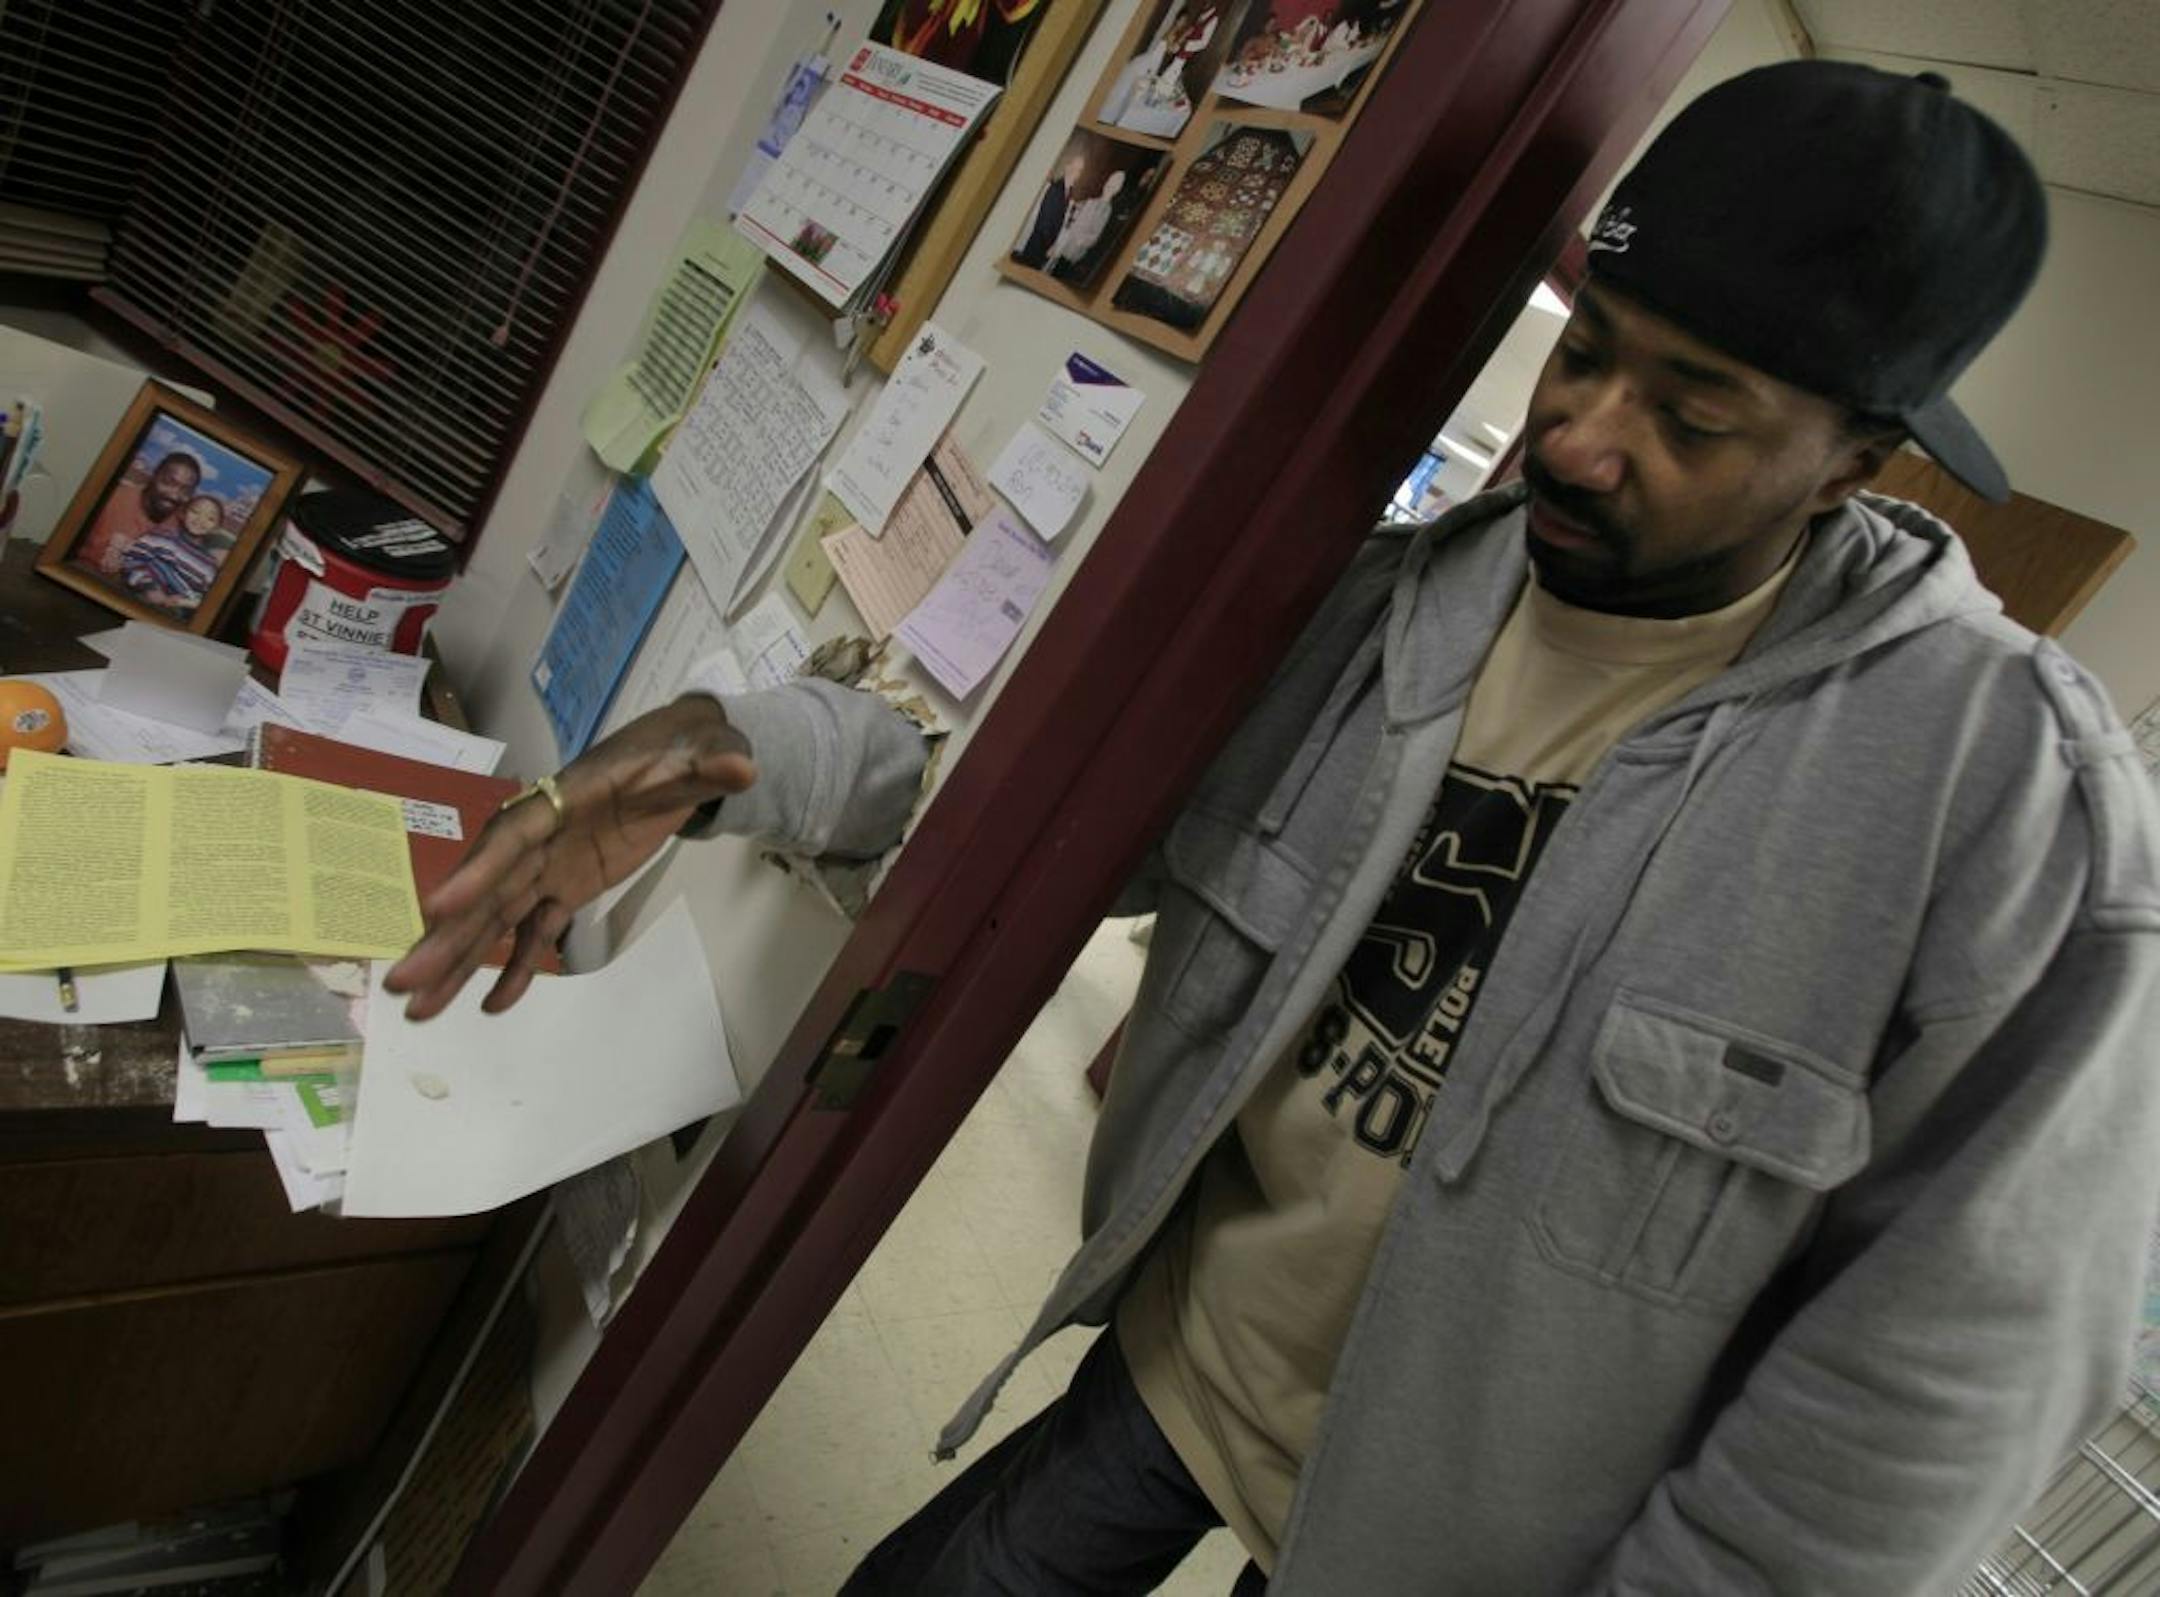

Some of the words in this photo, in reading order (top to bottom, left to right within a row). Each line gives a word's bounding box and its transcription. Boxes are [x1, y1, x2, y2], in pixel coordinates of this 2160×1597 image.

[299, 609, 321, 623] ST
[331, 598, 380, 622] HELP
[1413, 964, 1482, 1068] POLE
